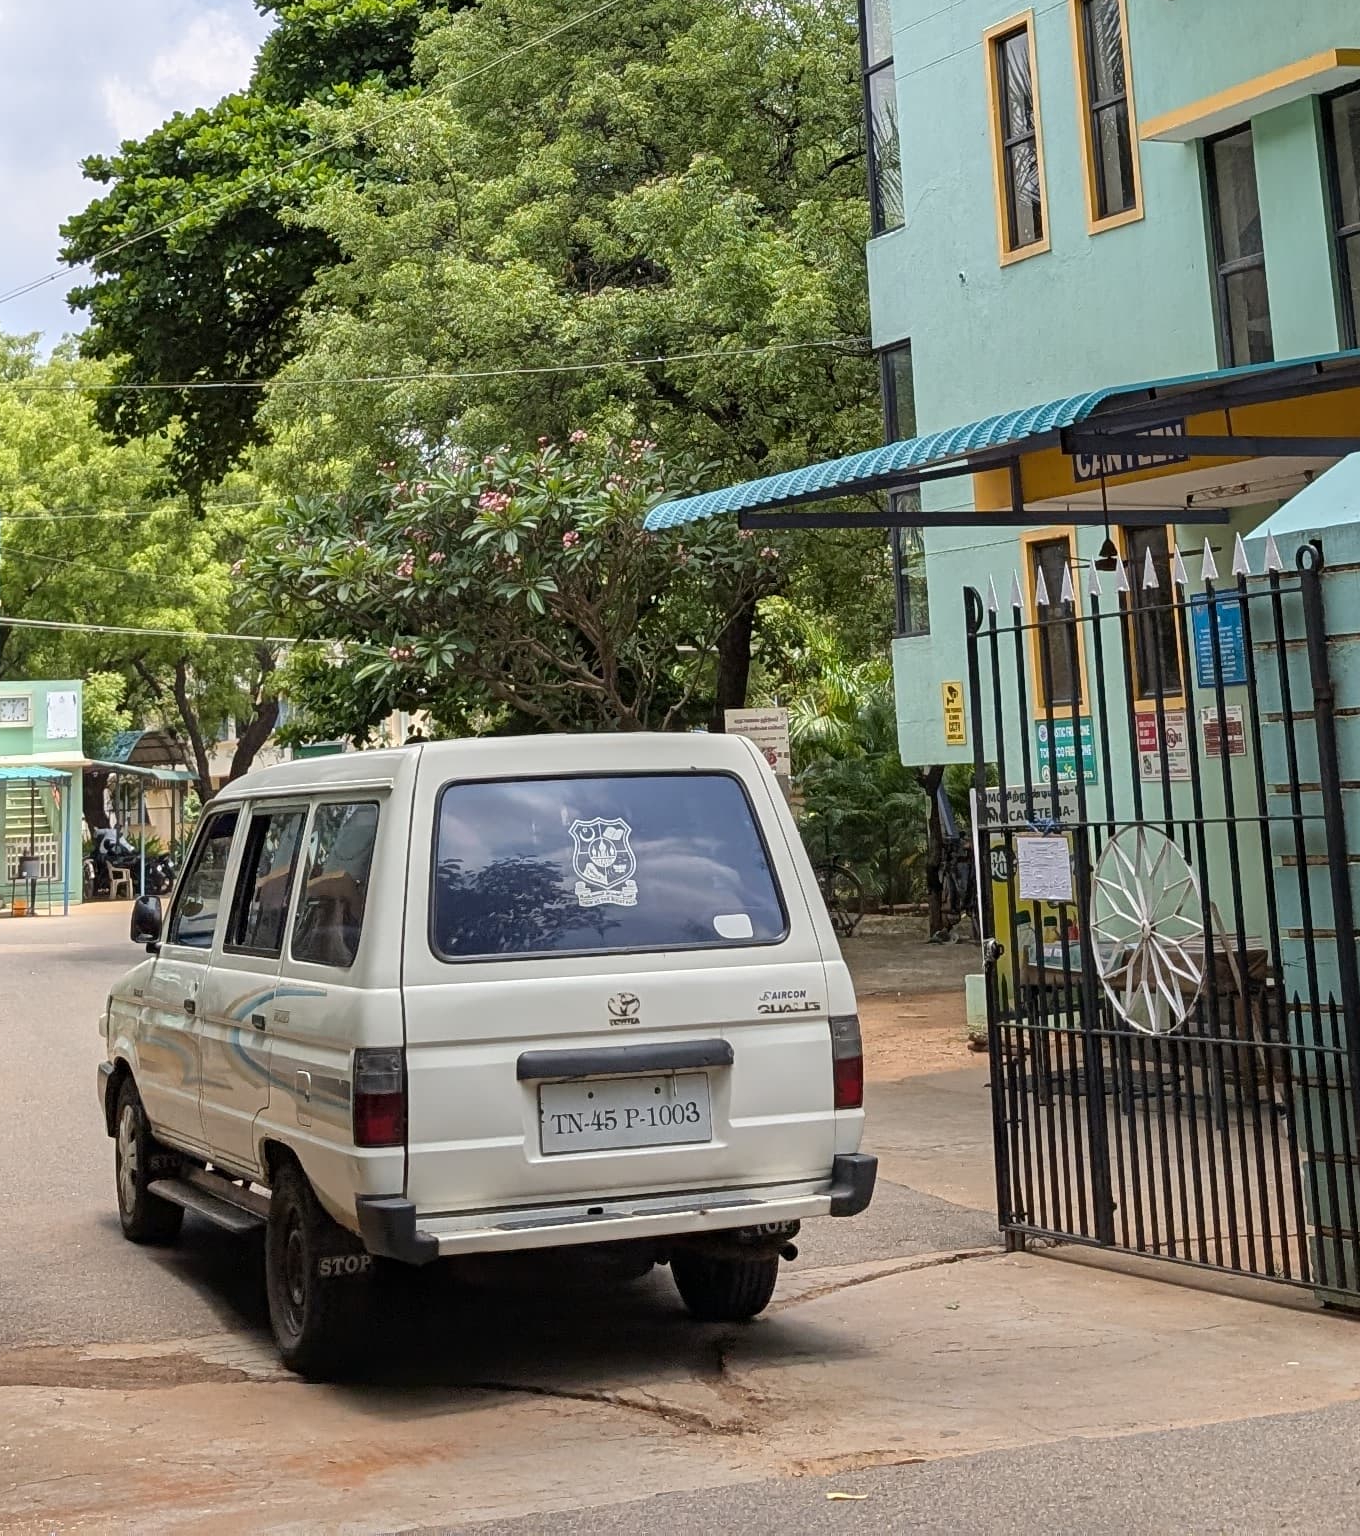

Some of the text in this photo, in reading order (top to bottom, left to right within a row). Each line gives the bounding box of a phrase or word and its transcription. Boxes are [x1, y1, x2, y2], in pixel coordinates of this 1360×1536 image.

[771, 990, 806, 1001] AIRCON
[551, 1101, 700, 1135] TN-45 P-1003
[320, 1254, 371, 1276] STOP
